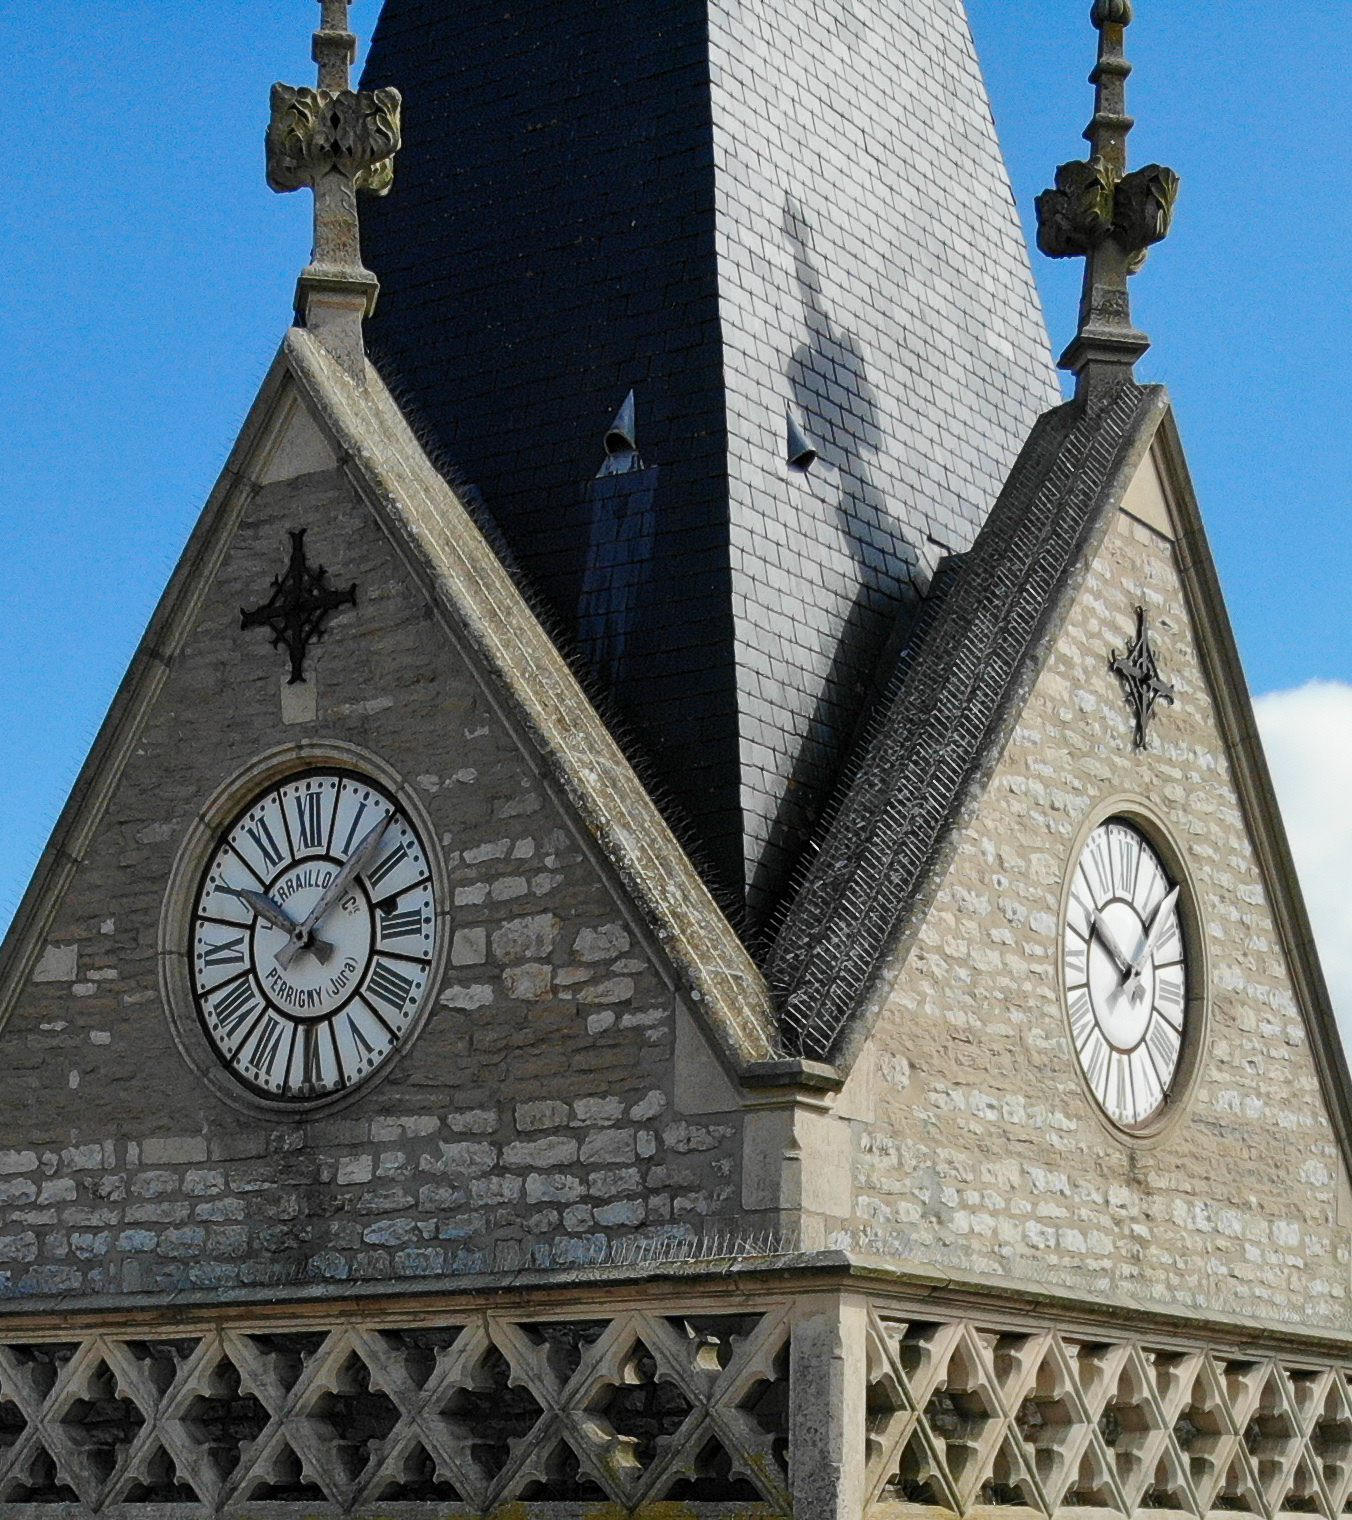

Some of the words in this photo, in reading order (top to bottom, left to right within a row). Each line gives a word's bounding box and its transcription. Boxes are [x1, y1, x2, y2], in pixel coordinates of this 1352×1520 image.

[246, 815, 286, 876] XI
[294, 791, 324, 852] XII
[341, 801, 367, 857] I
[269, 868, 333, 909] ERRAILLO
[367, 840, 410, 892] II
[204, 935, 246, 968] IX
[379, 907, 422, 943] III
[213, 976, 260, 1041] VIII
[265, 966, 324, 1009] PERRIGNY
[325, 956, 359, 998] (Jura)
[365, 959, 414, 1014] IIII
[249, 1013, 286, 1077] VII
[346, 1012, 376, 1063] V
